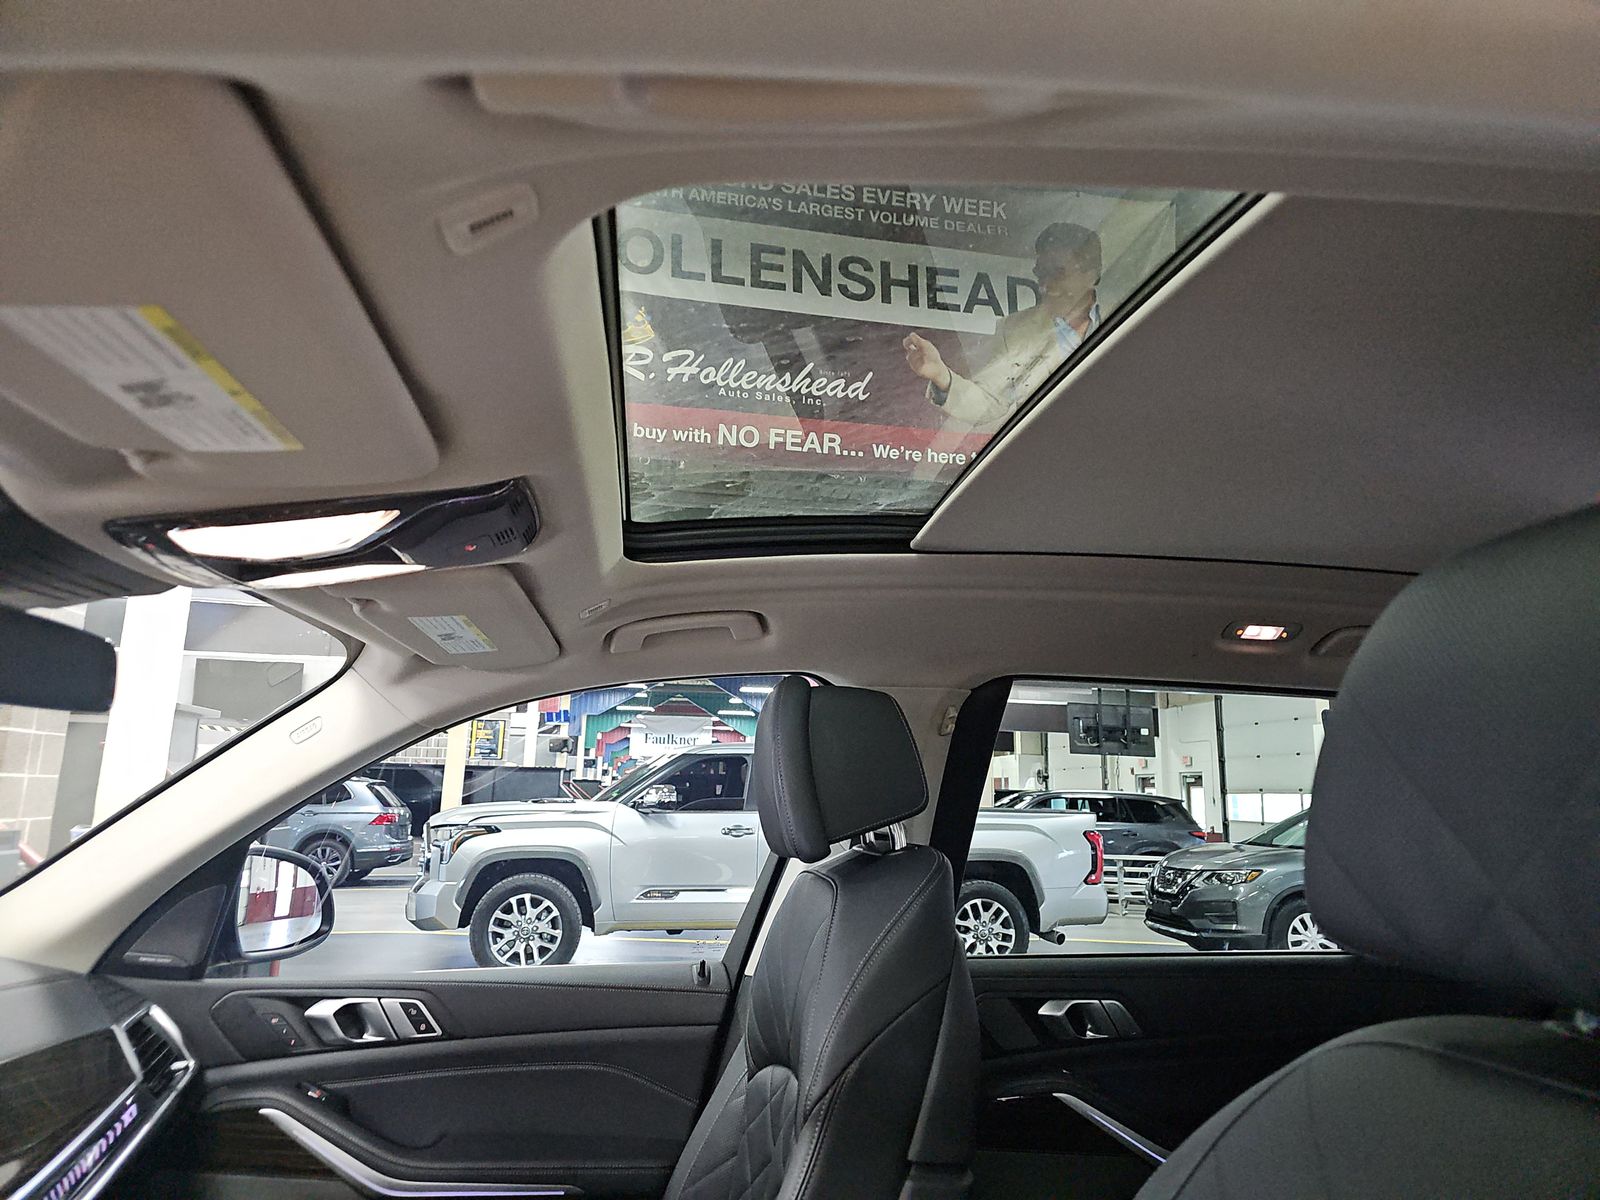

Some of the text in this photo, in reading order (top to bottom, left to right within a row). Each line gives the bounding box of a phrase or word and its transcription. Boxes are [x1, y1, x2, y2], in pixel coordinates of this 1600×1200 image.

[688, 188, 783, 211] AMERICA'S
[787, 200, 864, 221] LARGEST
[869, 209, 940, 229] VOLUME
[780, 182, 1007, 220] SALES EVERY WEEK
[662, 349, 873, 401] Hollenshead
[718, 387, 826, 406] Auto Sales, Inc.
[633, 422, 667, 443] buy
[672, 426, 711, 444] with
[717, 423, 760, 448] NO
[768, 428, 864, 457] FEAR...
[872, 443, 922, 462] We're
[927, 448, 966, 465] here
[644, 732, 699, 746] Faulkner
